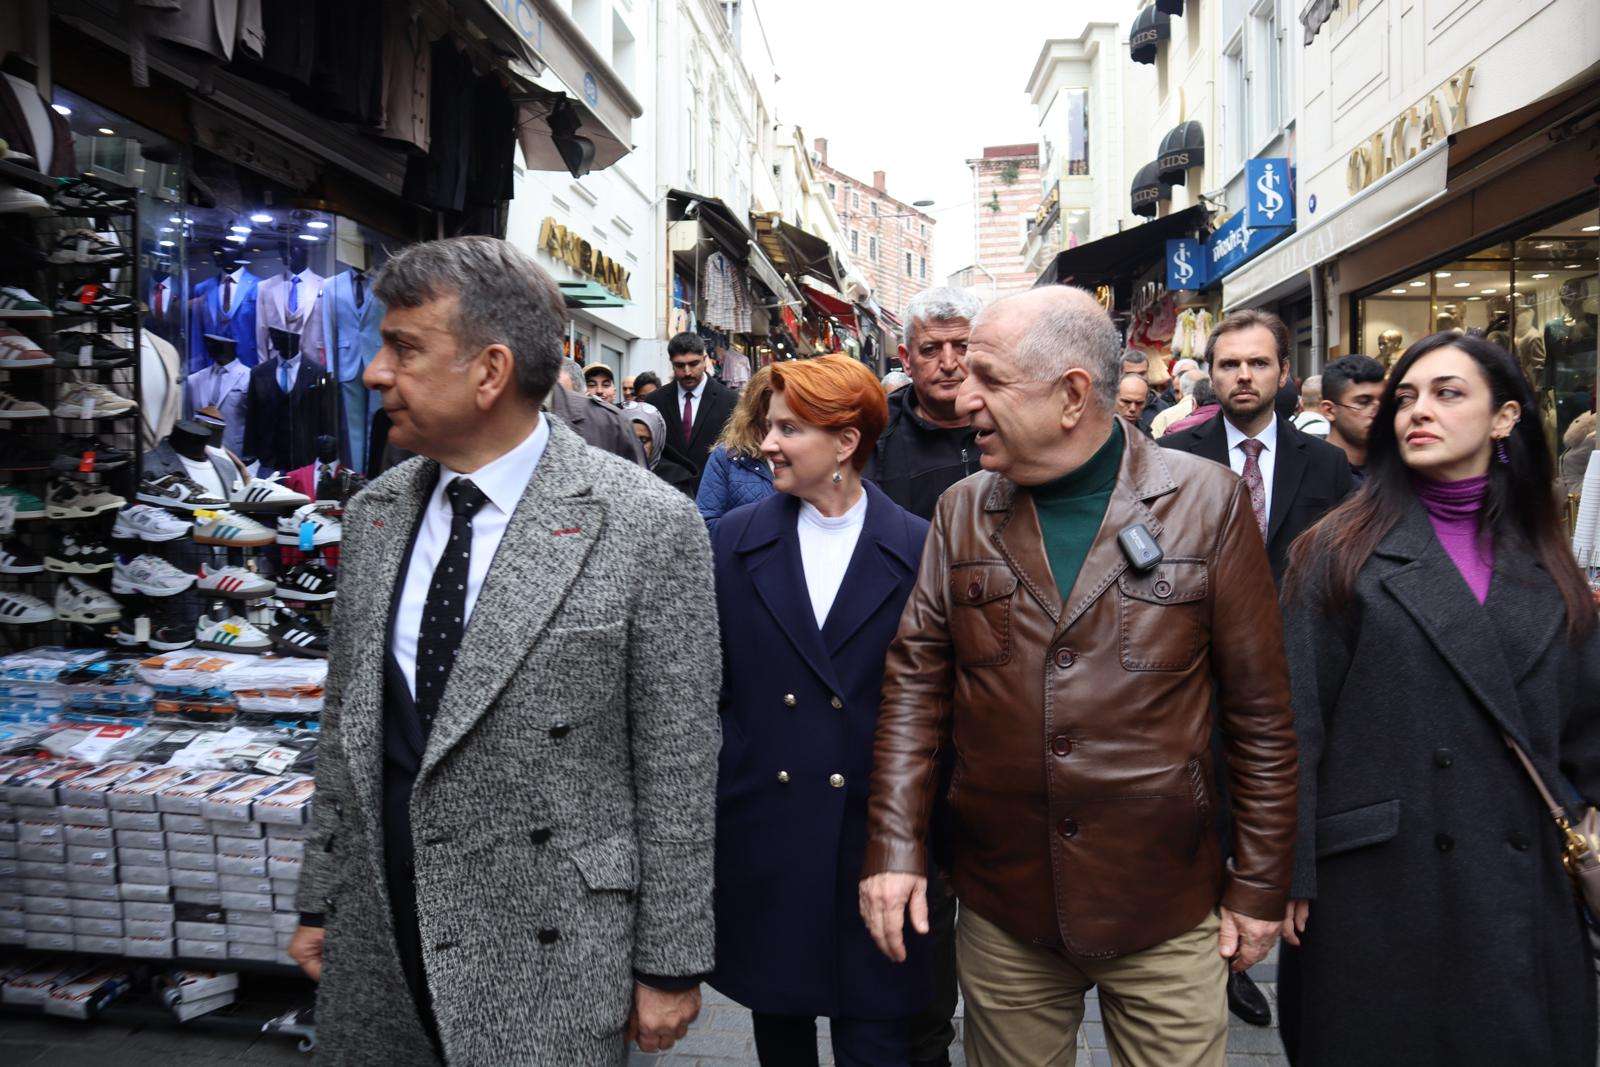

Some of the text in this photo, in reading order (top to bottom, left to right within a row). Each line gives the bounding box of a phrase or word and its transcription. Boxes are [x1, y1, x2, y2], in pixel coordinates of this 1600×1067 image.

[1160, 153, 1189, 170] KIDS
[1346, 65, 1476, 196] OLCAY
[537, 216, 632, 301] AKBANK
